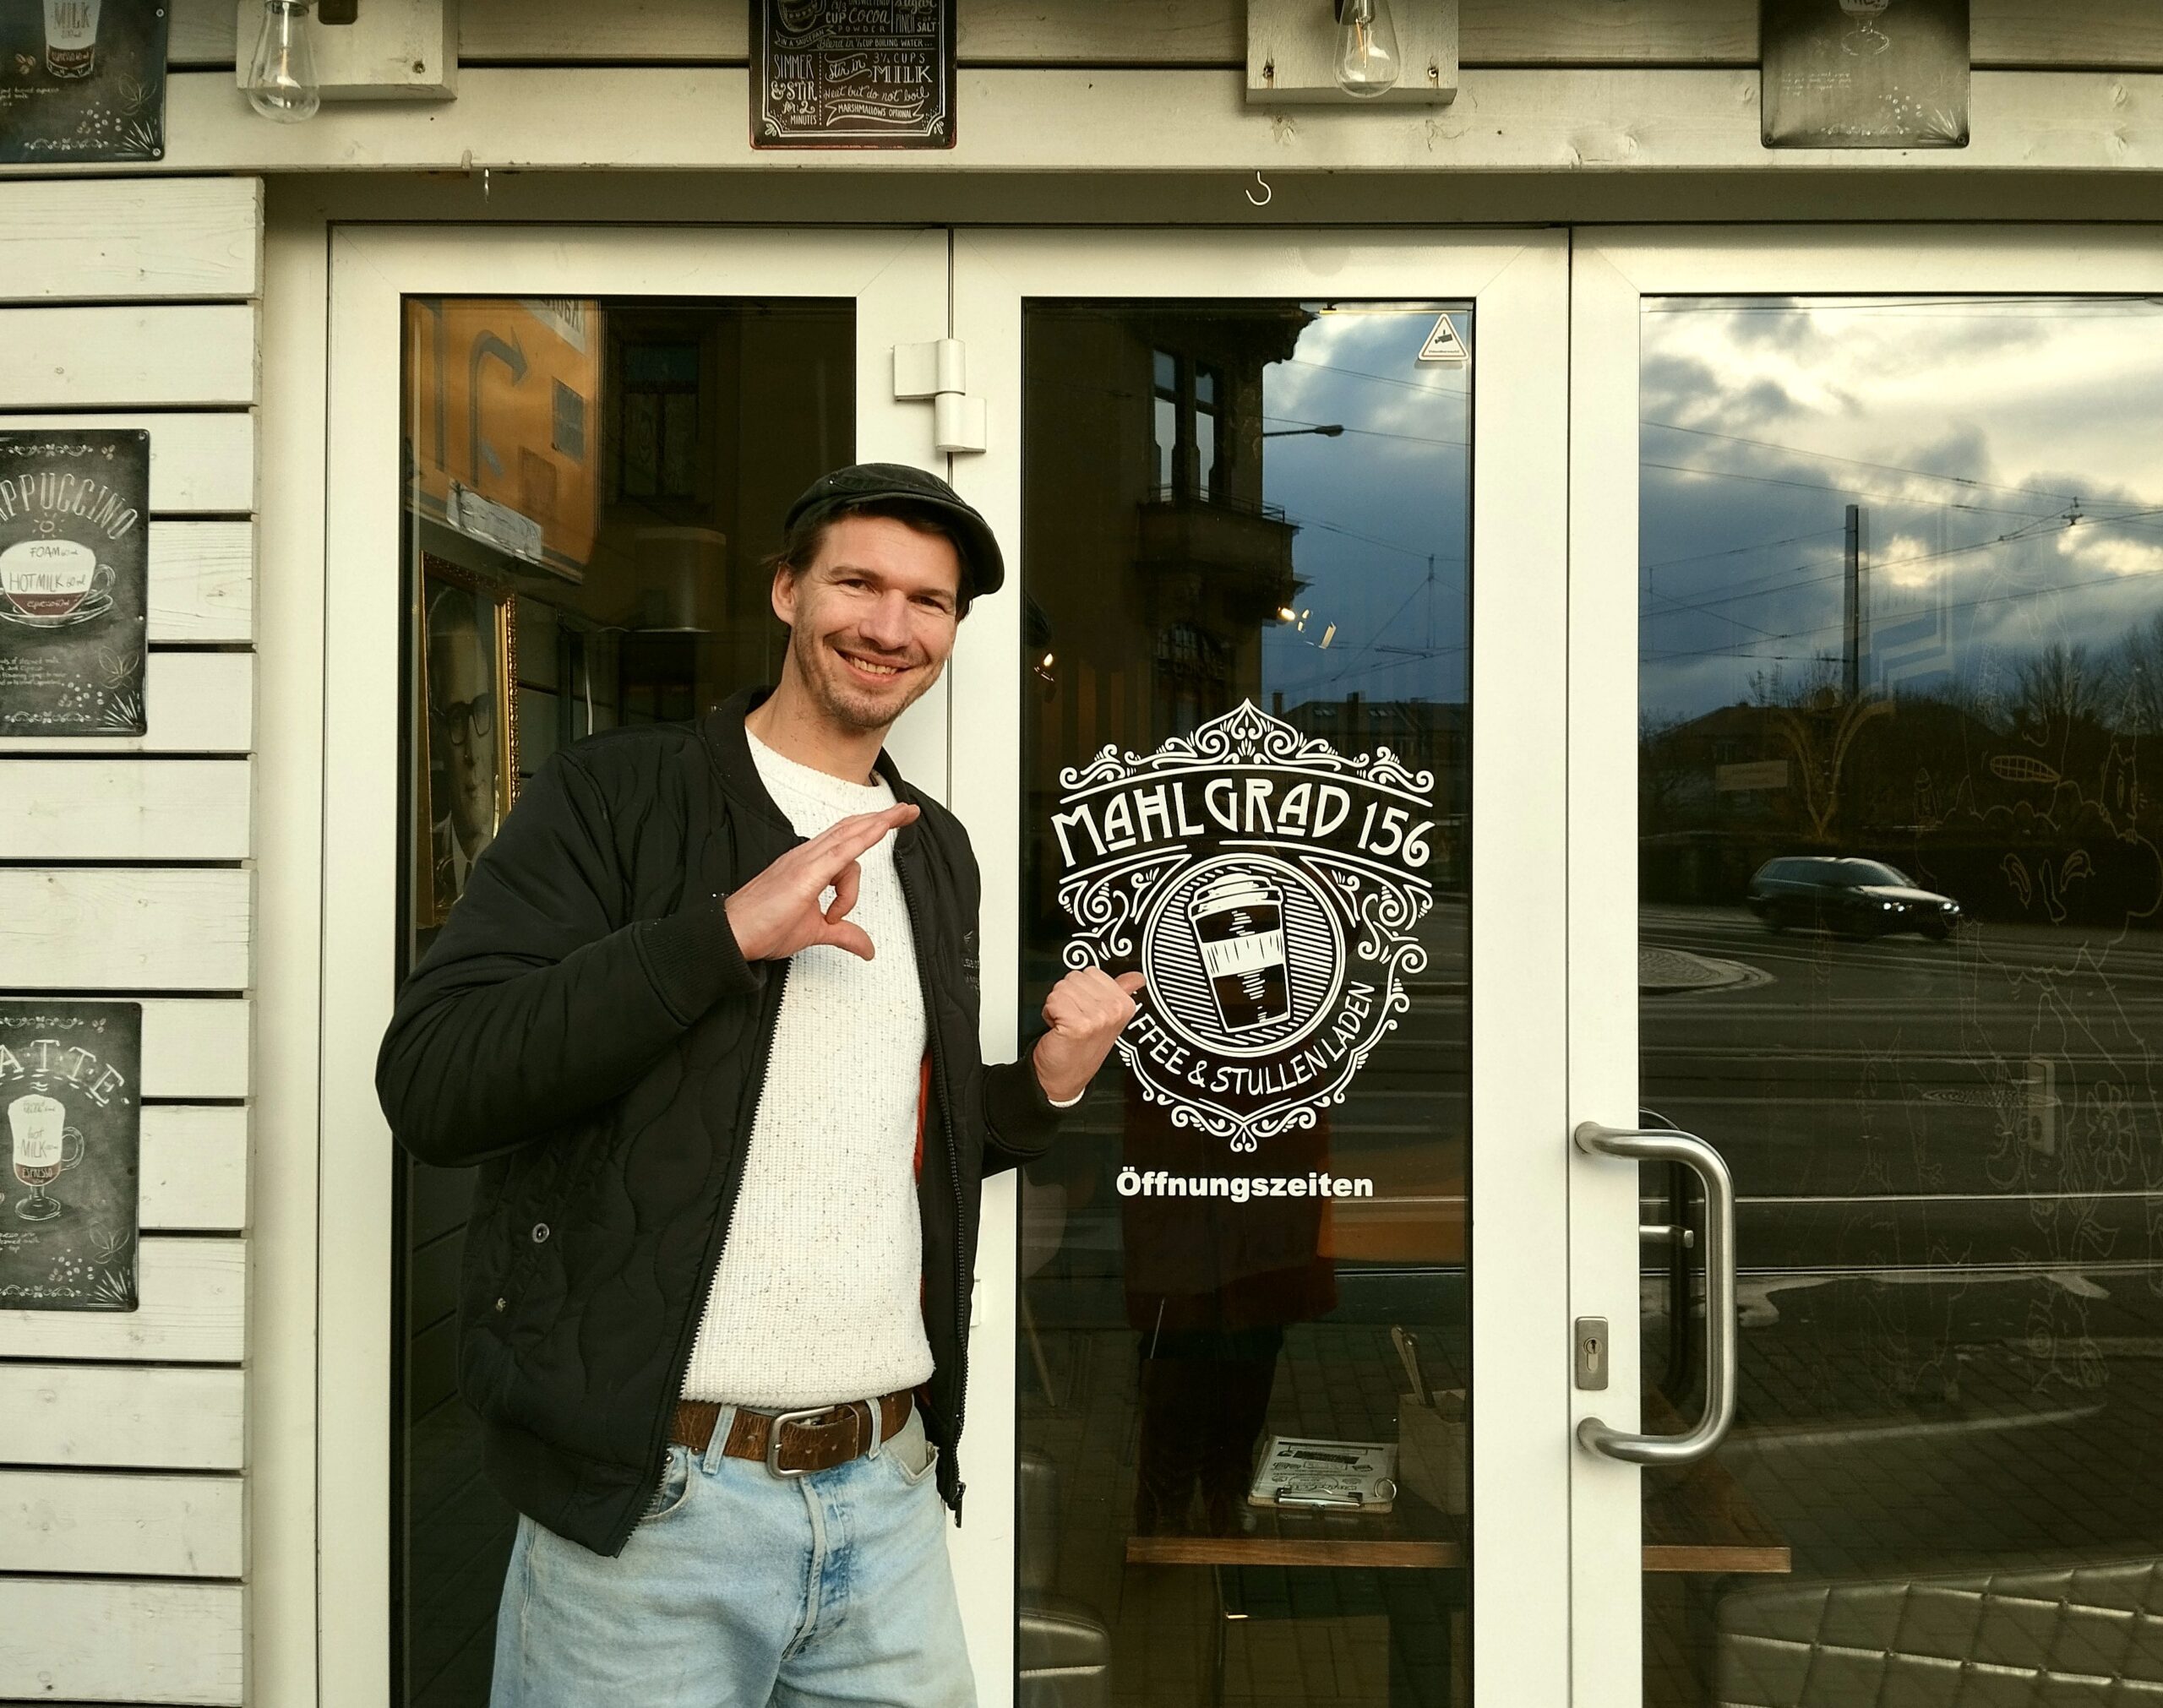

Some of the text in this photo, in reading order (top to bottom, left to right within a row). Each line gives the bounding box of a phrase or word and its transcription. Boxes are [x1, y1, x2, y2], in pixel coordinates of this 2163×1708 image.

[825, 8, 891, 24] CUP Cocoa
[896, 14, 915, 34] PINCH
[837, 24, 885, 33] POWDER
[917, 21, 937, 33] SALT
[862, 38, 874, 48] CUP
[874, 38, 898, 48] BOILING
[774, 53, 815, 80] SIMMER
[893, 52, 925, 64] CUPS
[872, 65, 934, 84] MILK
[823, 84, 930, 102] Heat but do not boil
[798, 100, 816, 114] 2
[837, 103, 913, 119] MARSHMALLOWS OPTIONAL
[790, 114, 817, 126] MINUTES
[0, 471, 139, 541] PPUCCINO
[29, 546, 60, 558] FOAM
[9, 572, 36, 592] HOT
[36, 572, 64, 592] MILK
[1356, 801, 1436, 868] 156
[1187, 1060, 1208, 1089] &
[21, 1138, 47, 1159] MILK
[22, 1167, 53, 1178] ESPRESSO
[1115, 1166, 1374, 1204] Öffnungszeiten
